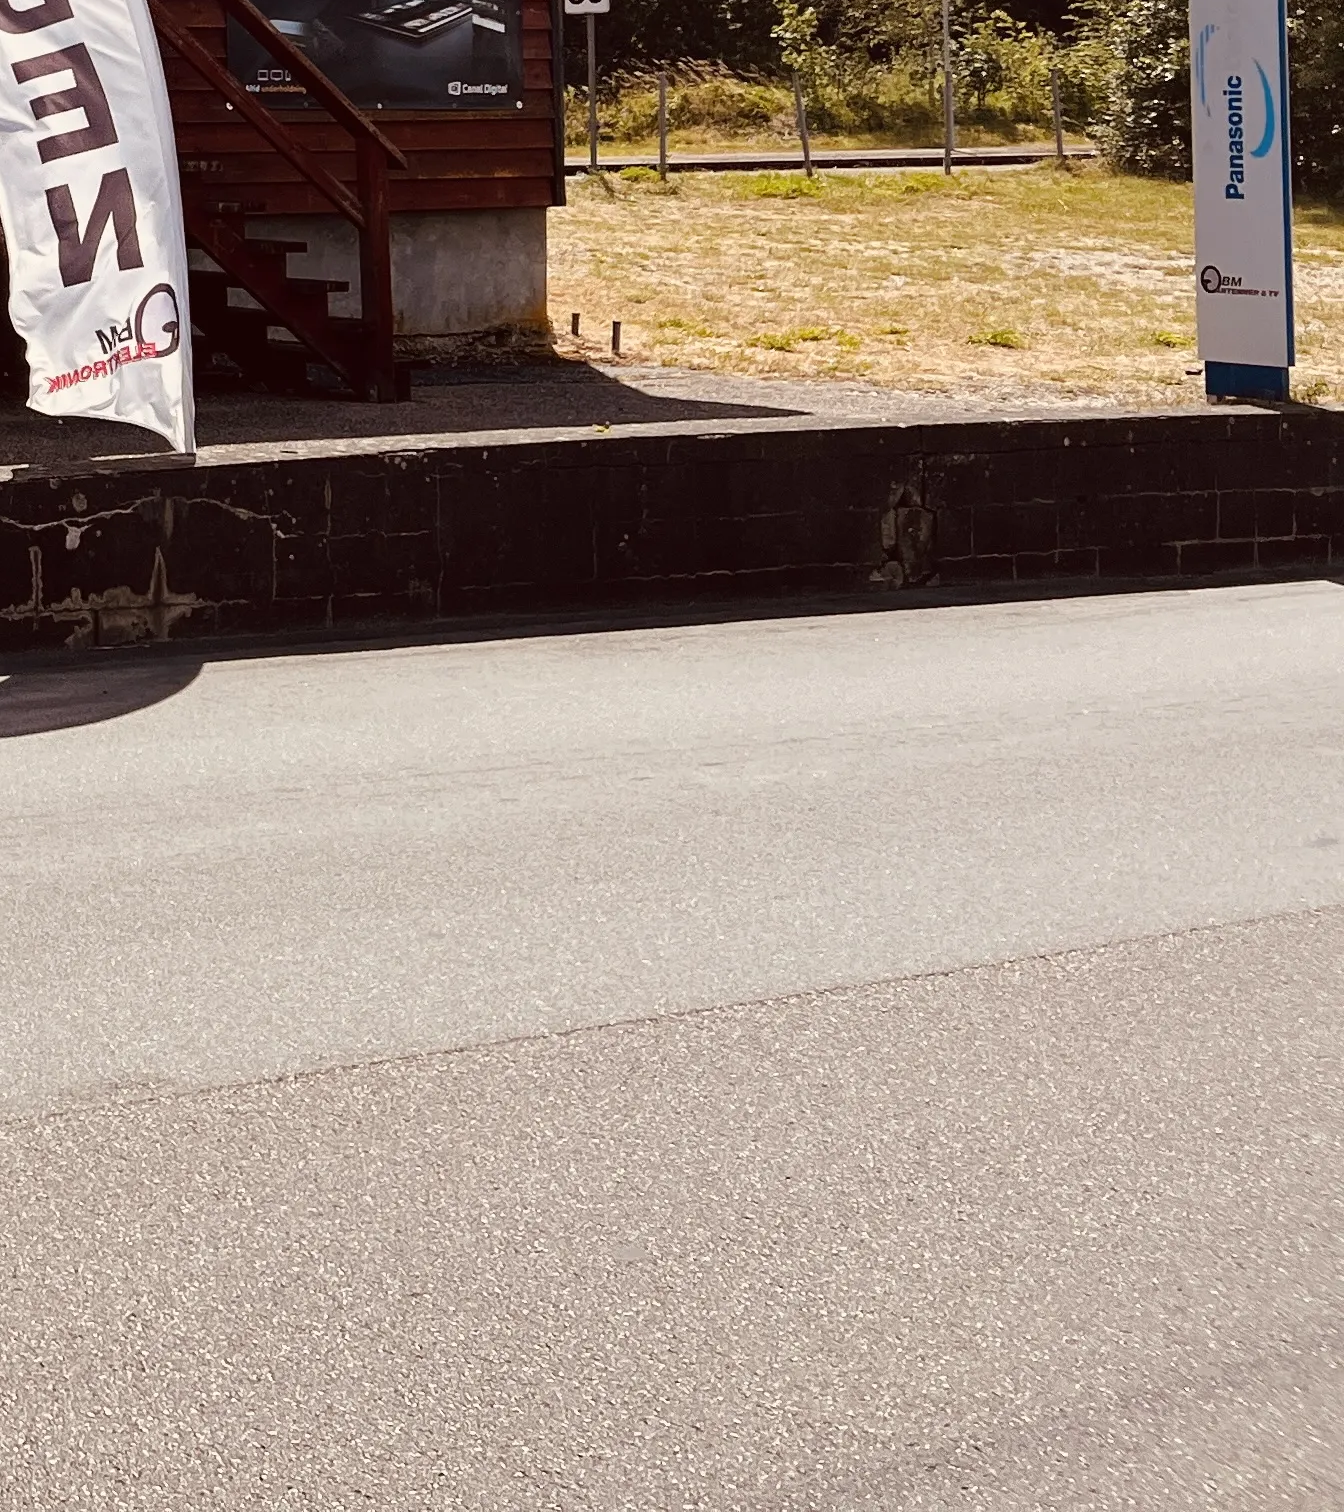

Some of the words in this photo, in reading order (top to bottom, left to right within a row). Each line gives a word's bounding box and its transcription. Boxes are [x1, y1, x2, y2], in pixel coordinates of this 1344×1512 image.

[462, 83, 483, 94] Canal
[484, 83, 509, 96] Digital
[1223, 74, 1245, 200] Panasonic
